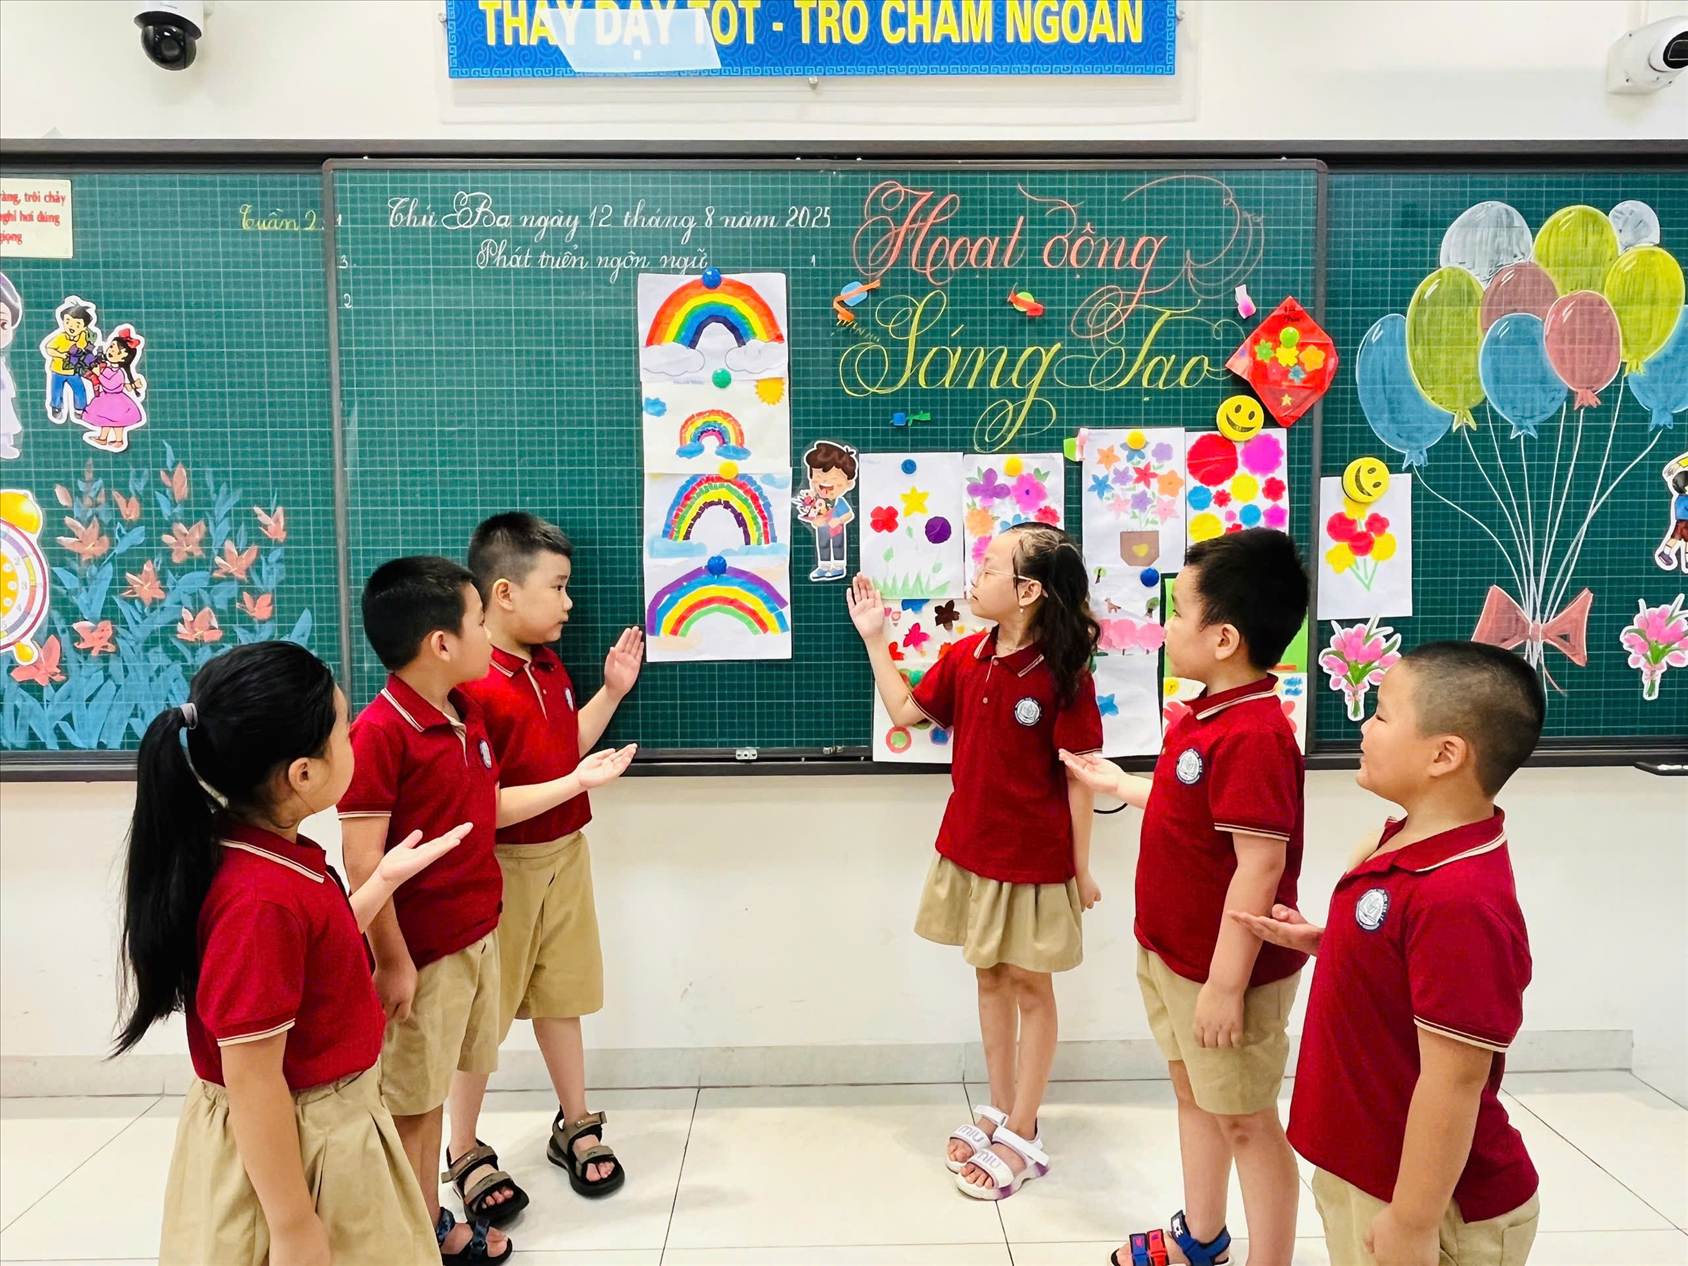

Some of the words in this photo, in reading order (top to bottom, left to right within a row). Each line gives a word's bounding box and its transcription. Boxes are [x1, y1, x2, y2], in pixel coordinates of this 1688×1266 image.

[772, 22, 784, 32] -
[1006, 0, 1143, 44] NGOAN
[24, 191, 41, 202] trôi
[44, 191, 66, 206] chảy
[239, 204, 299, 231] Tuần
[388, 198, 437, 228] Thứ
[519, 209, 580, 243] ngày
[588, 205, 613, 228] 12
[623, 199, 697, 245] tháng
[704, 205, 715, 228] 8
[719, 210, 780, 228] năm
[785, 206, 831, 228] 2025
[476, 239, 531, 269] Phát
[539, 244, 588, 269] triển
[596, 250, 650, 284] ngôn
[659, 248, 708, 275] ngữ
[839, 290, 1062, 453] Sáng
[1054, 300, 1213, 402] Tạo
